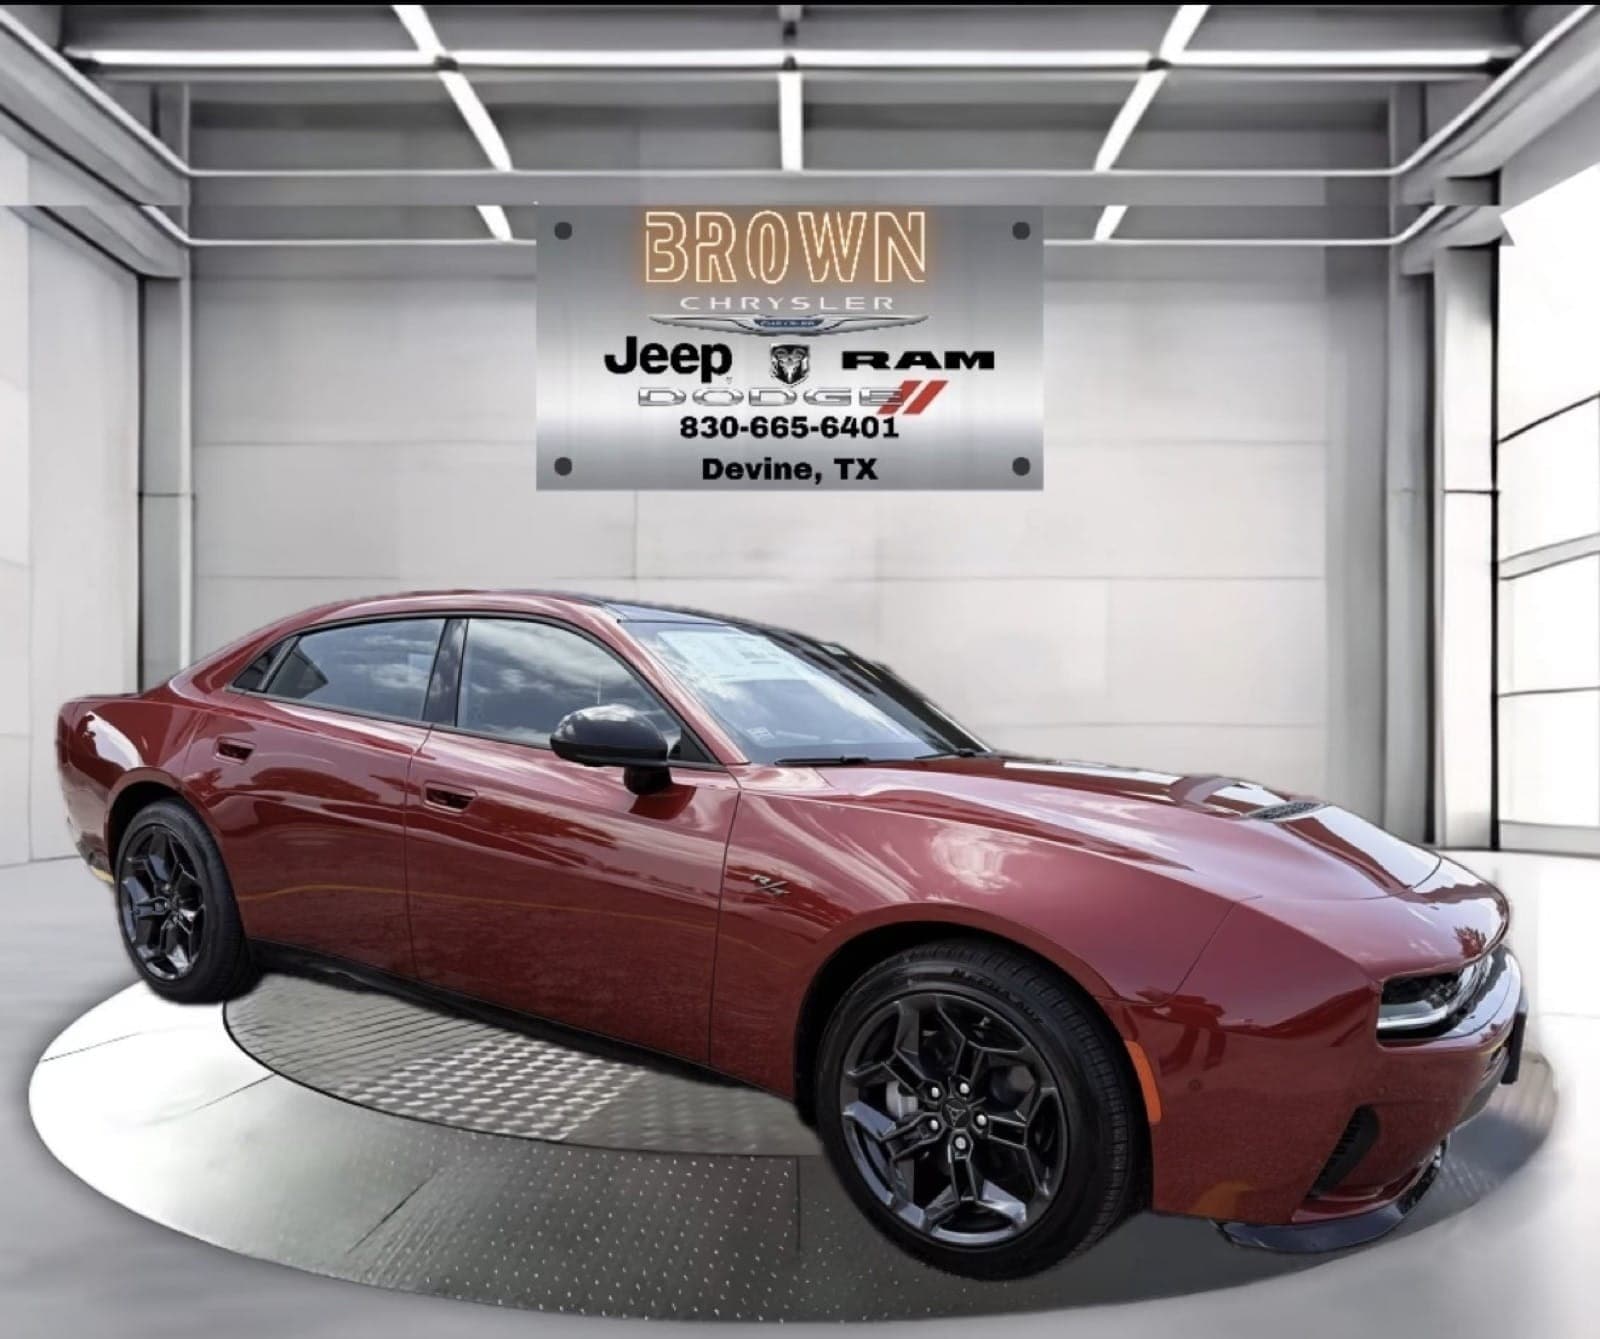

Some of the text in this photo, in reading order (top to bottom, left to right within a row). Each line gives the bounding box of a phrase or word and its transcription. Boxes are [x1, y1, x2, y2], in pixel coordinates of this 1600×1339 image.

[645, 211, 926, 283] BROWN
[680, 296, 894, 311] CHRYSLER
[604, 336, 732, 383] Jeep
[841, 350, 995, 370] RAM
[638, 387, 904, 407] DODGE
[679, 416, 900, 438] 830-665-6401
[702, 457, 879, 485] Devine, TX
